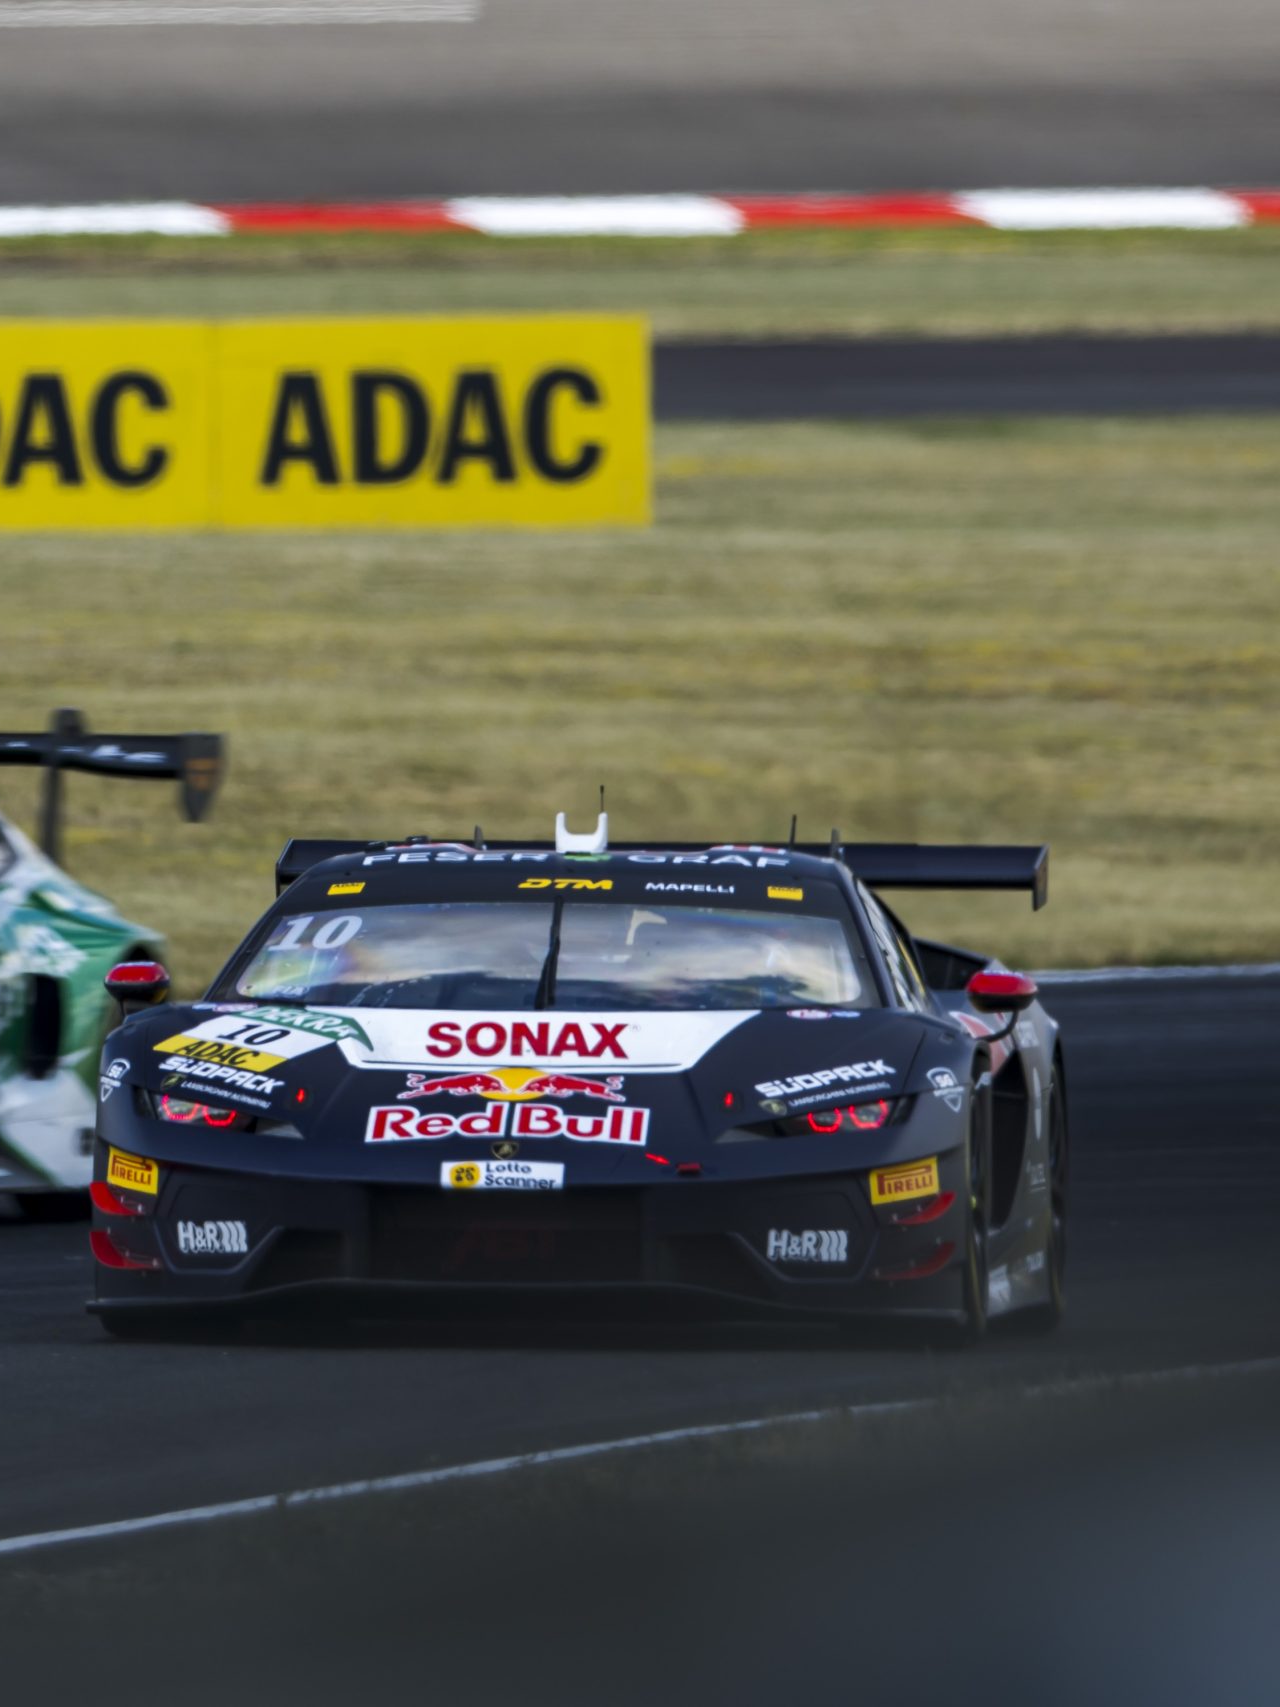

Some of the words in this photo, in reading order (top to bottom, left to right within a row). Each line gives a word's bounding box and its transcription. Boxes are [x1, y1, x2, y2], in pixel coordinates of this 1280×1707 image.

[259, 367, 604, 486] ADAC
[362, 851, 549, 866] FESER
[627, 854, 789, 868] GRAF
[518, 878, 614, 891] DTM
[644, 881, 735, 894] MAPELLI
[267, 915, 363, 951] 10
[216, 1023, 291, 1046] 10
[240, 1005, 360, 1038] DEKRA
[174, 1040, 260, 1067] ADAC
[425, 1021, 629, 1060] SONAX
[754, 1058, 897, 1098] SÜDPACK
[367, 1102, 508, 1142] Red
[513, 1103, 647, 1144] Bull
[111, 1154, 153, 1186] PIRELLI
[484, 1173, 556, 1190] Scanner
[485, 1161, 532, 1174] Lotto
[877, 1164, 934, 1196] PIRELLI
